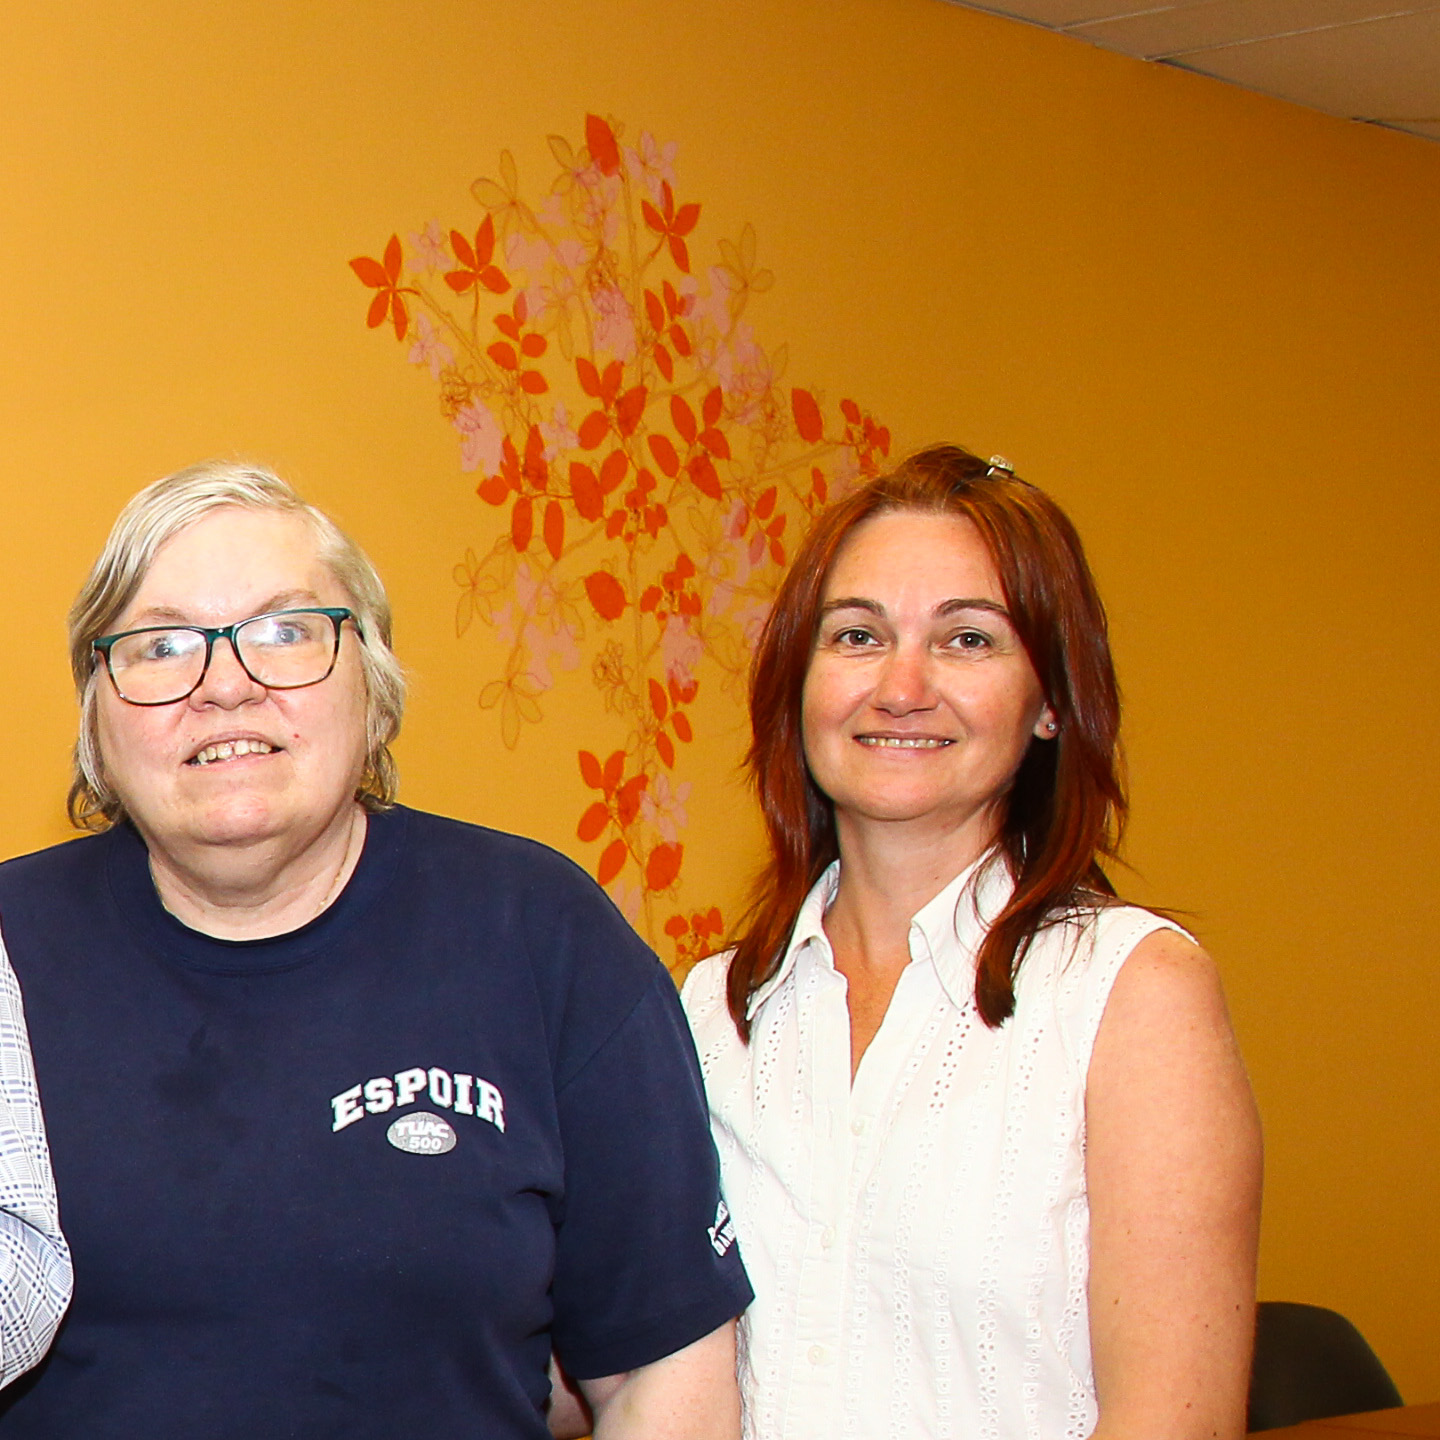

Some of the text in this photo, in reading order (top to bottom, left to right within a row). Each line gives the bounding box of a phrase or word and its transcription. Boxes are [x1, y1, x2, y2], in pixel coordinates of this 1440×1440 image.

[330, 1067, 506, 1133] ESPOIR
[395, 1121, 450, 1138] TUAC
[408, 1136, 442, 1151] 500
